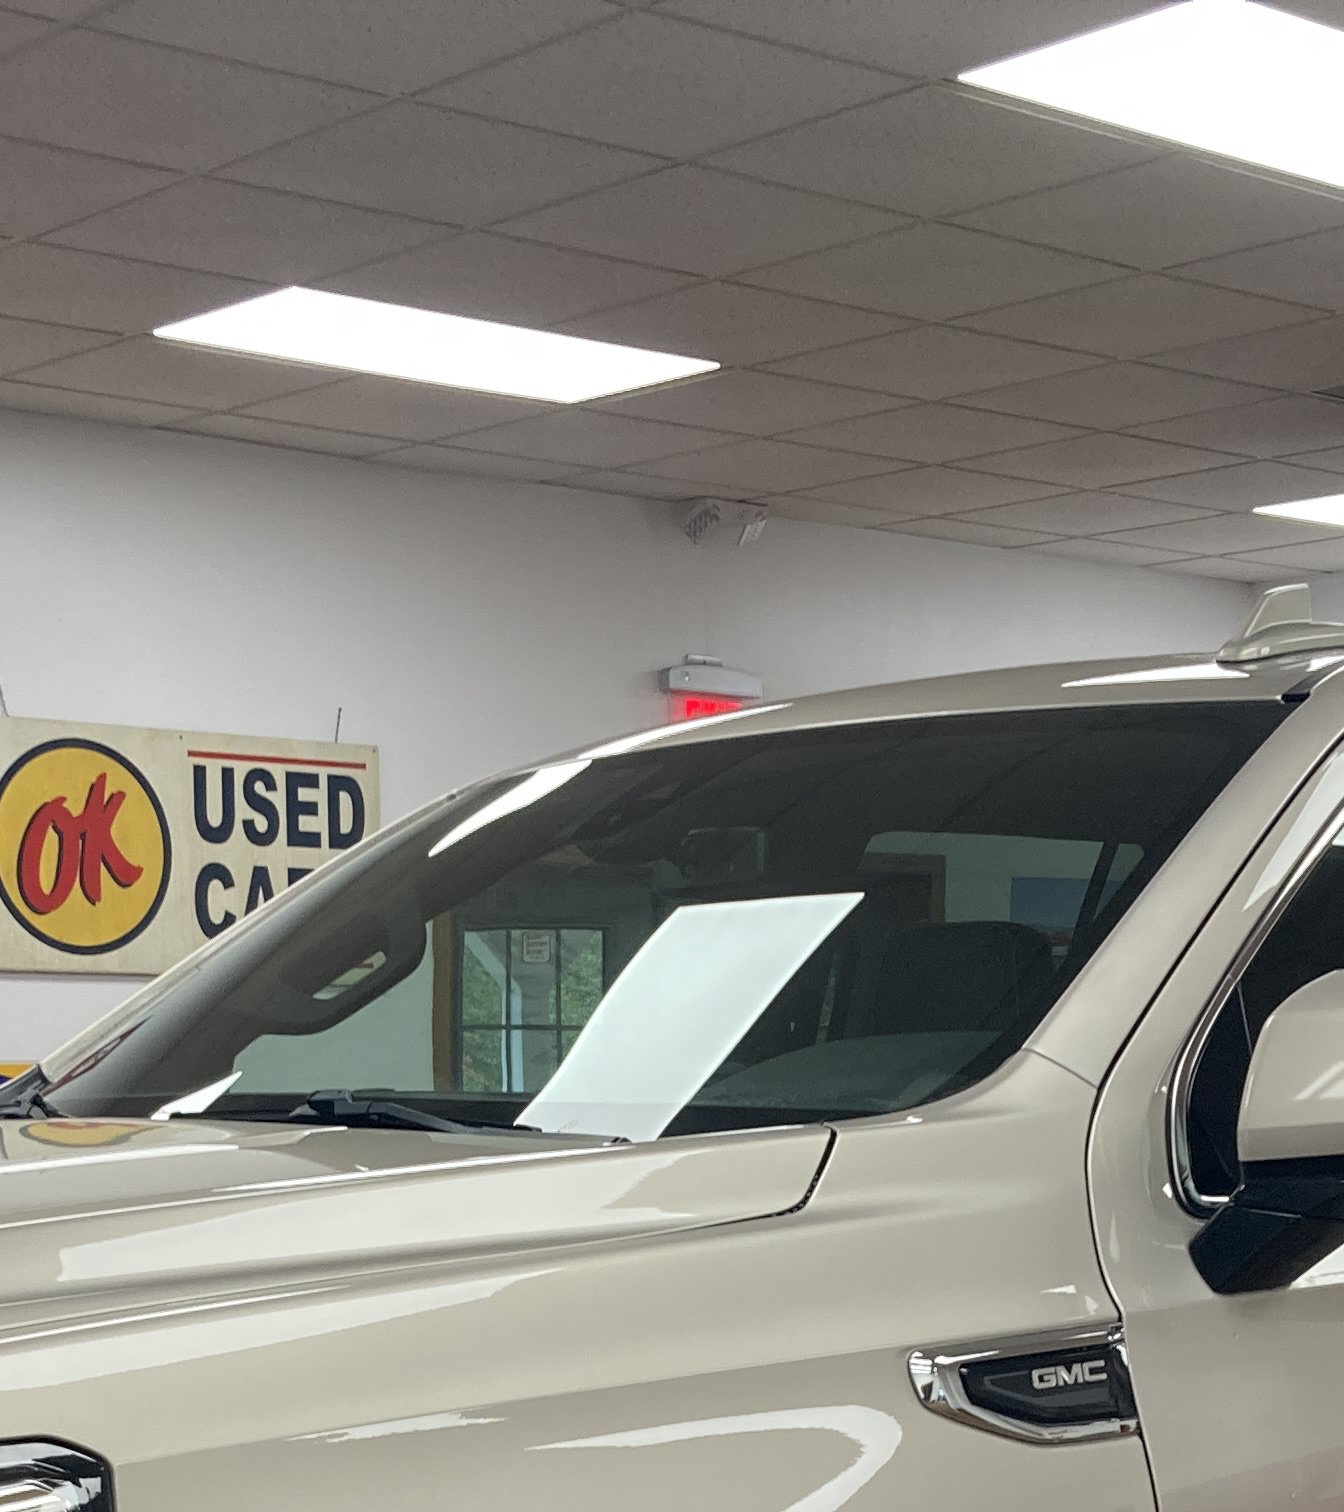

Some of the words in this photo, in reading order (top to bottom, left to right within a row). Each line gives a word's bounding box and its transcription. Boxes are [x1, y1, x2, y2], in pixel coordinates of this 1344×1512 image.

[17, 772, 144, 915] OK
[193, 764, 366, 849] USED
[195, 862, 315, 939] CA
[1031, 1359, 1108, 1390] GMC
